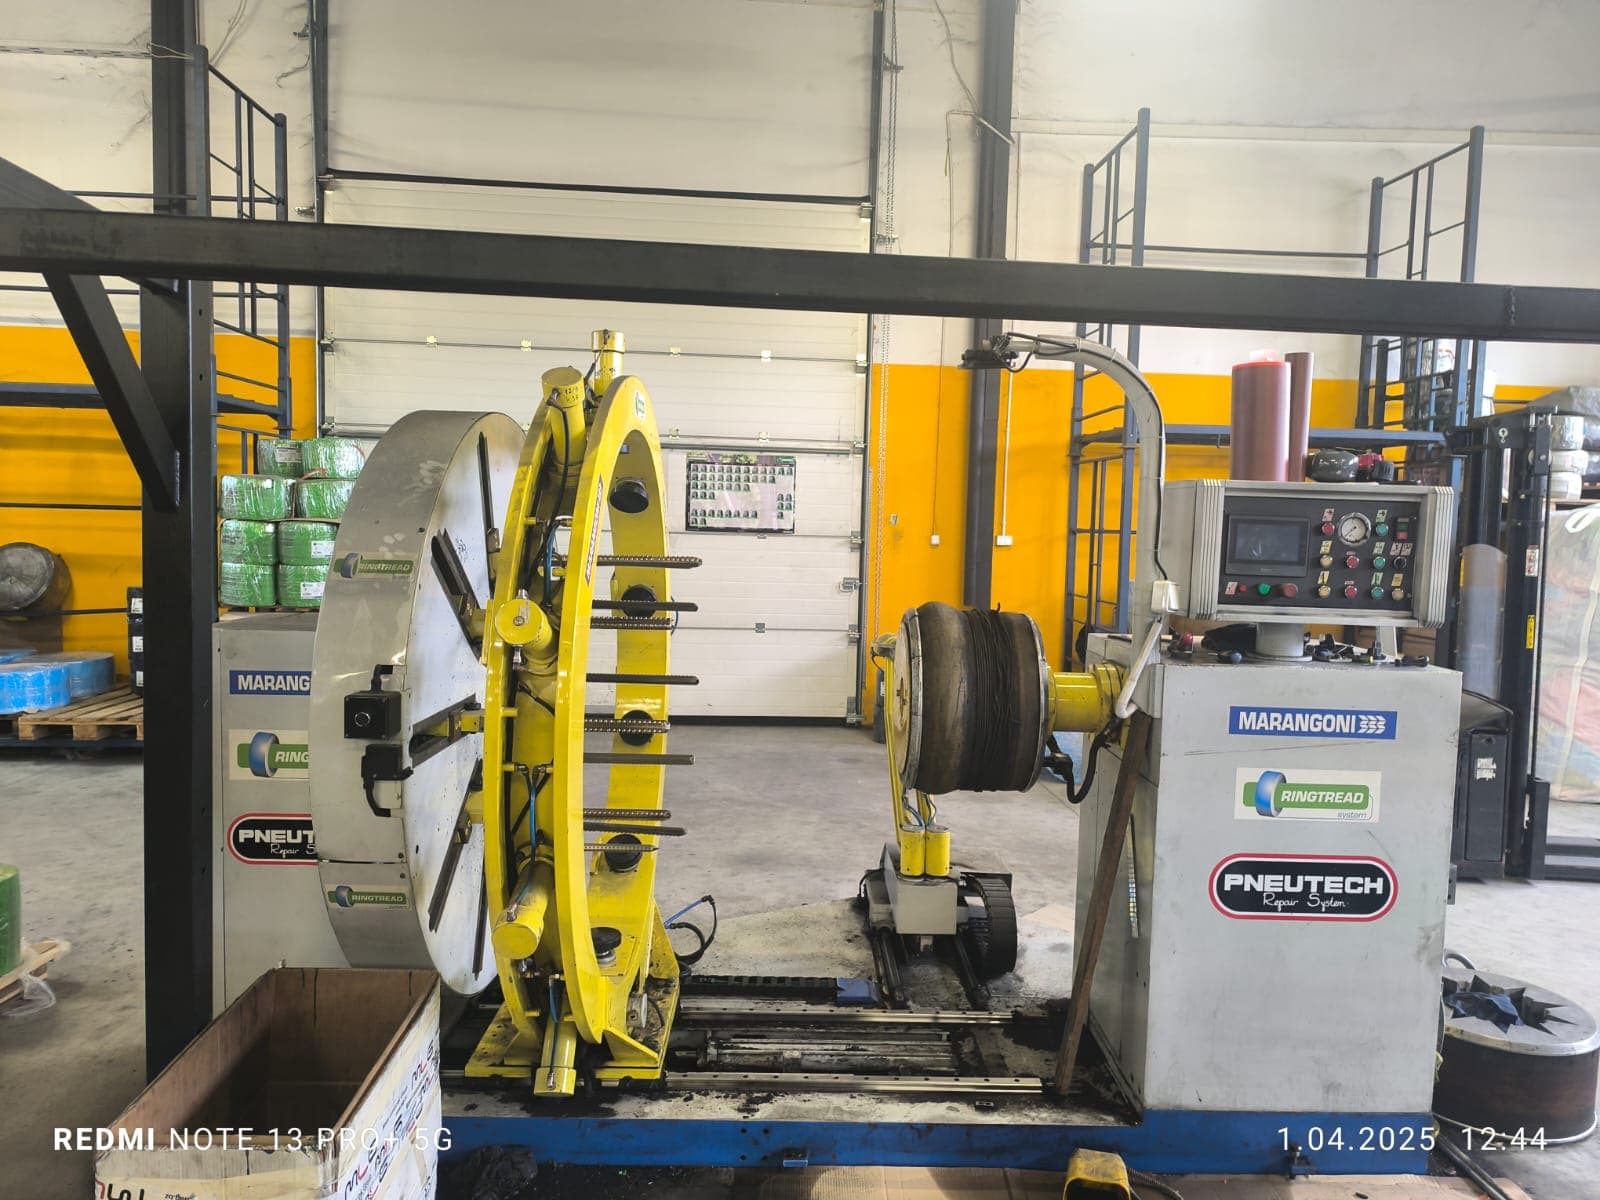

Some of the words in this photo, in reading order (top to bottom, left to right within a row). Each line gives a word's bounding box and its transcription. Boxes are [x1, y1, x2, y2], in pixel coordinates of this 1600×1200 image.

[237, 674, 311, 691] MARANG
[1238, 711, 1356, 734] MARANGONI
[1280, 790, 1364, 804] RINGTREAD
[1337, 810, 1367, 820] system
[238, 829, 315, 844] PNEUT
[270, 843, 300, 859] Repair
[1223, 873, 1384, 894] PNEUTECH
[351, 894, 403, 902] RINGTREAD
[1262, 892, 1299, 912] Repair
[1306, 893, 1347, 912] System
